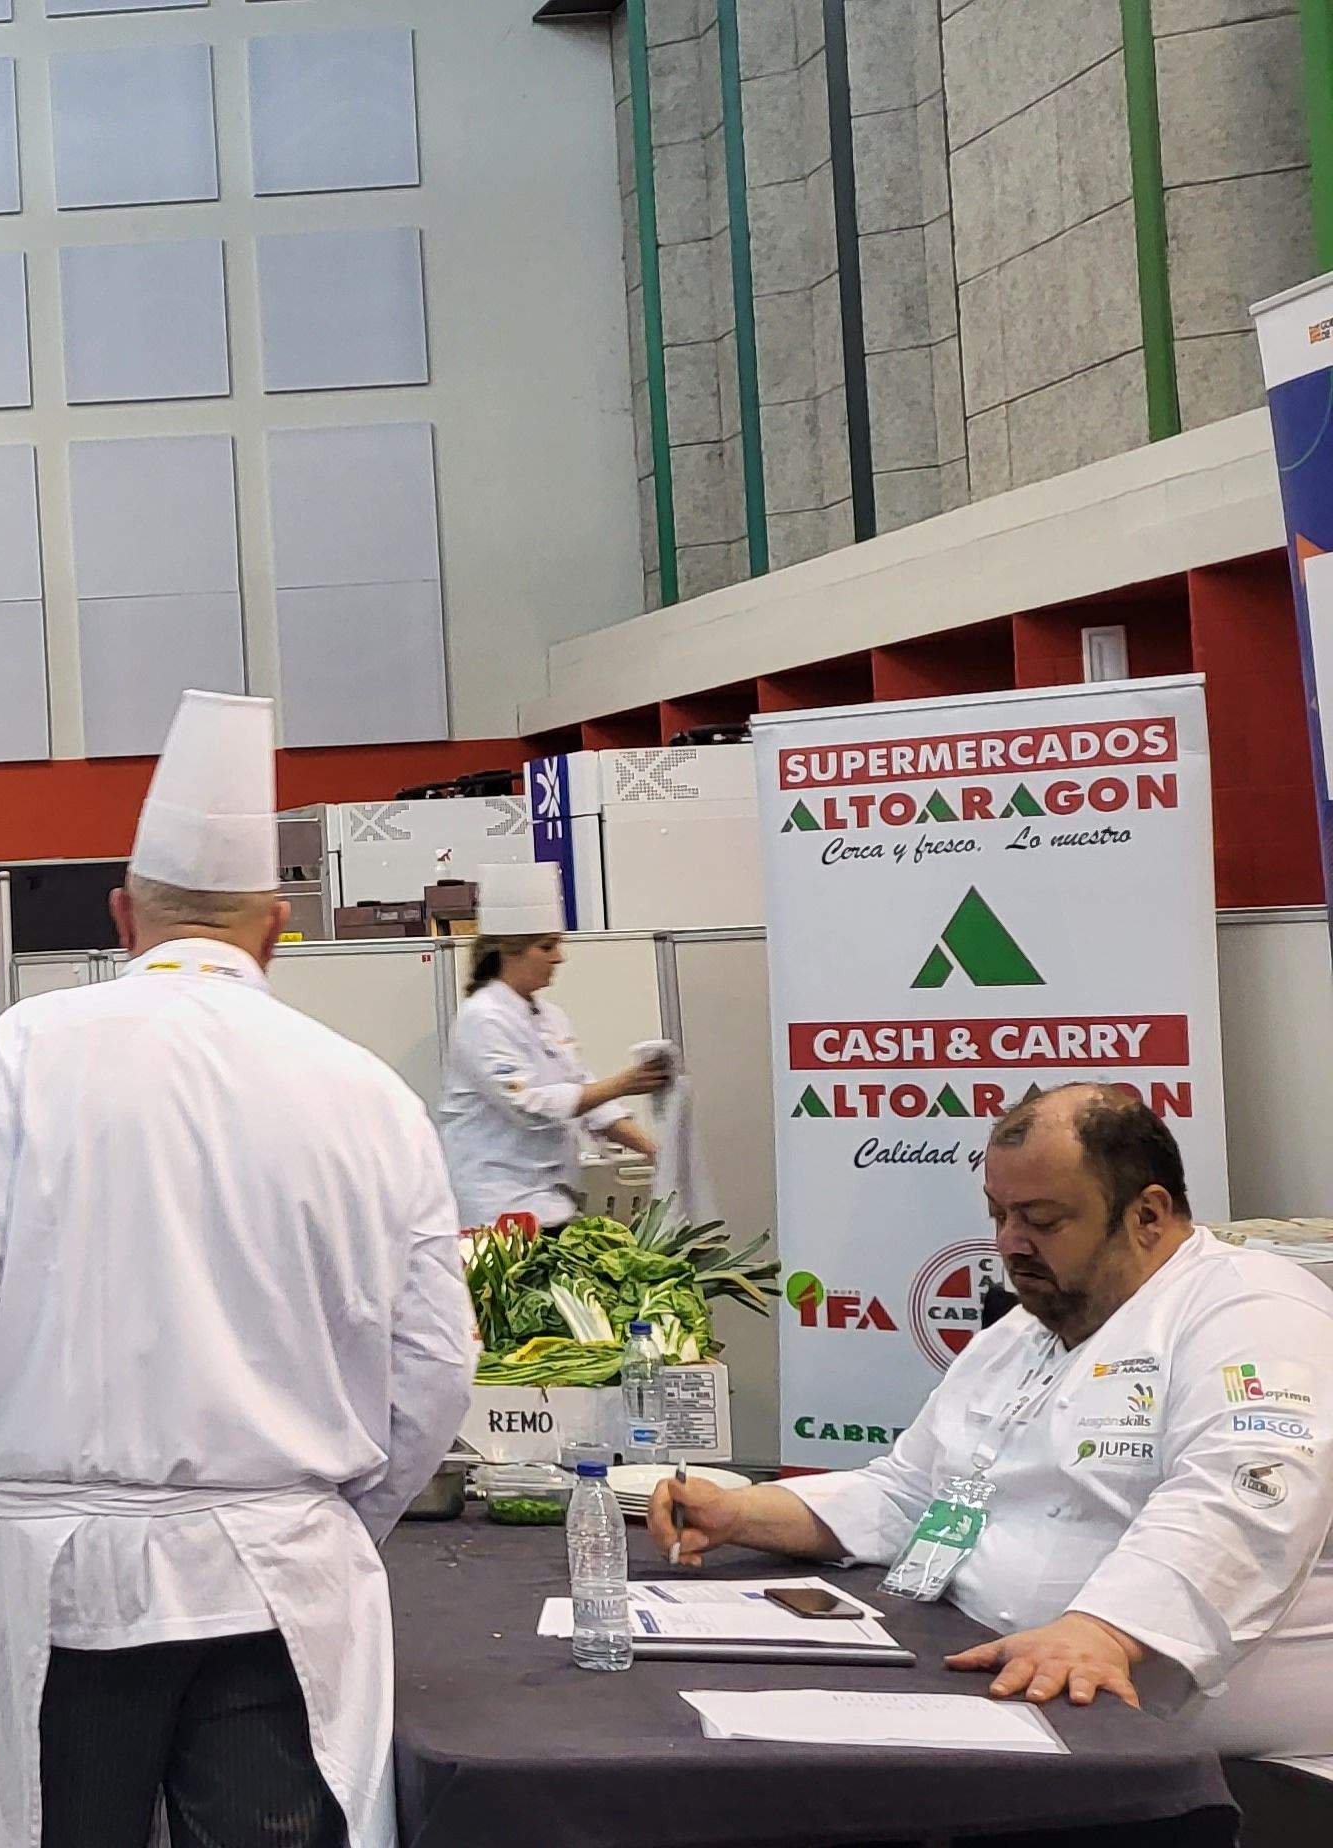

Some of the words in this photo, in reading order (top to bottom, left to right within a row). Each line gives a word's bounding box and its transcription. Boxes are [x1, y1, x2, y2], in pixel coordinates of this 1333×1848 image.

[785, 725, 1170, 783] SUPERMERCADOS
[780, 773, 1179, 834] ALTOARAGON
[821, 838, 885, 866] Cerca
[893, 842, 907, 864] y
[913, 834, 983, 864] fresco.
[1005, 826, 1041, 851] Lo
[1049, 828, 1133, 848] nuestro
[813, 1027, 935, 1063] CASH
[945, 1026, 983, 1061] &
[990, 1023, 1152, 1060] CARRY
[854, 1137, 960, 1169] Calidad
[488, 1409, 553, 1434] REMO
[1098, 1440, 1154, 1458] JUPER
